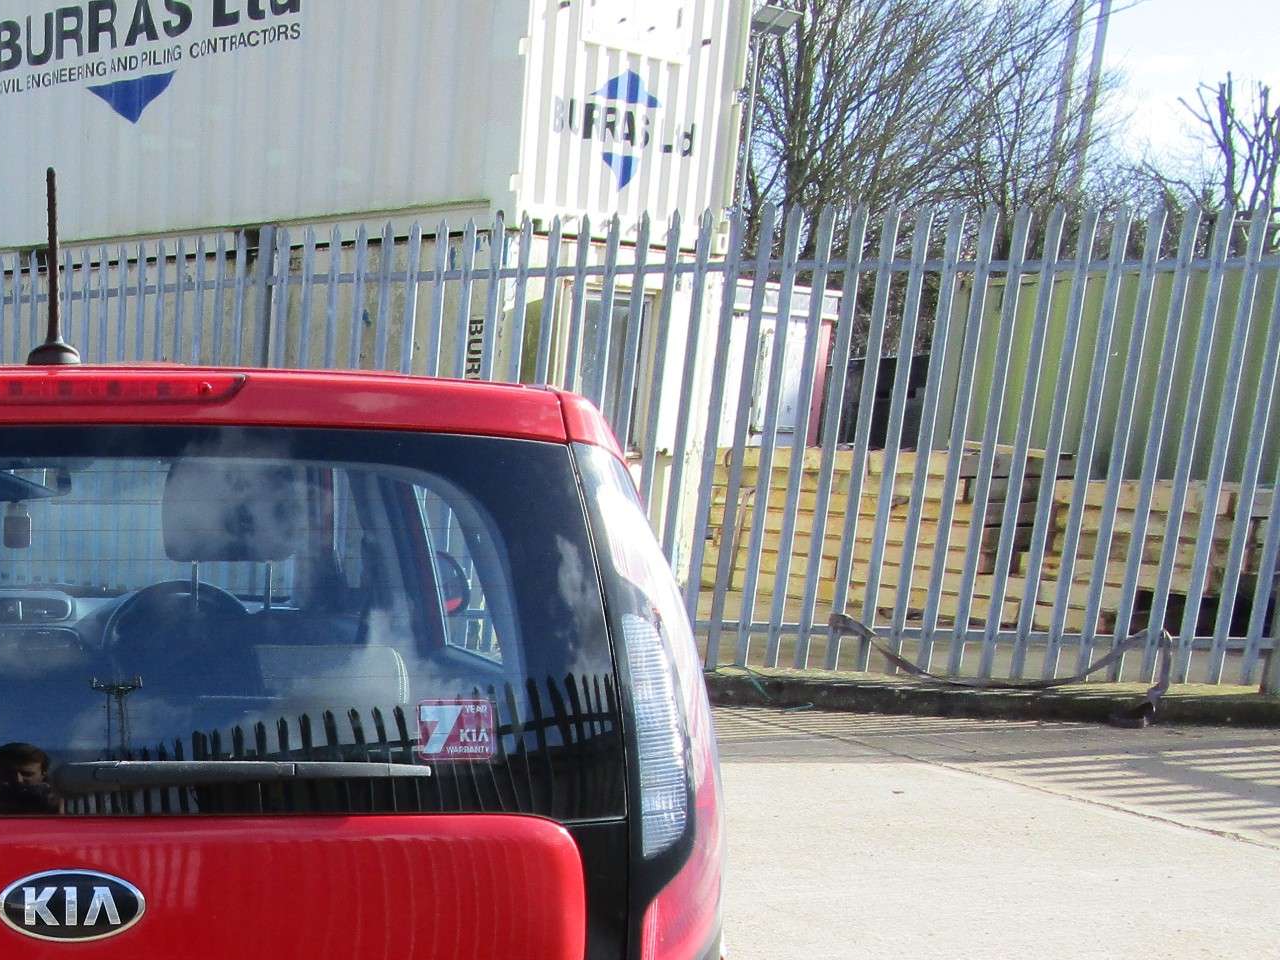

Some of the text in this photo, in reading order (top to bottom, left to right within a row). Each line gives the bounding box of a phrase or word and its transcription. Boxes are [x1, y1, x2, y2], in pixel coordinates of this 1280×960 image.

[111, 55, 138, 73] AND
[141, 44, 182, 68] PILING
[189, 22, 301, 59] CONTRACTORS
[466, 319, 483, 380] BUR
[421, 704, 487, 754] 7 YEAR
[446, 745, 489, 754] WARRANTY
[460, 729, 489, 742] KIA
[22, 886, 122, 926] KIA
